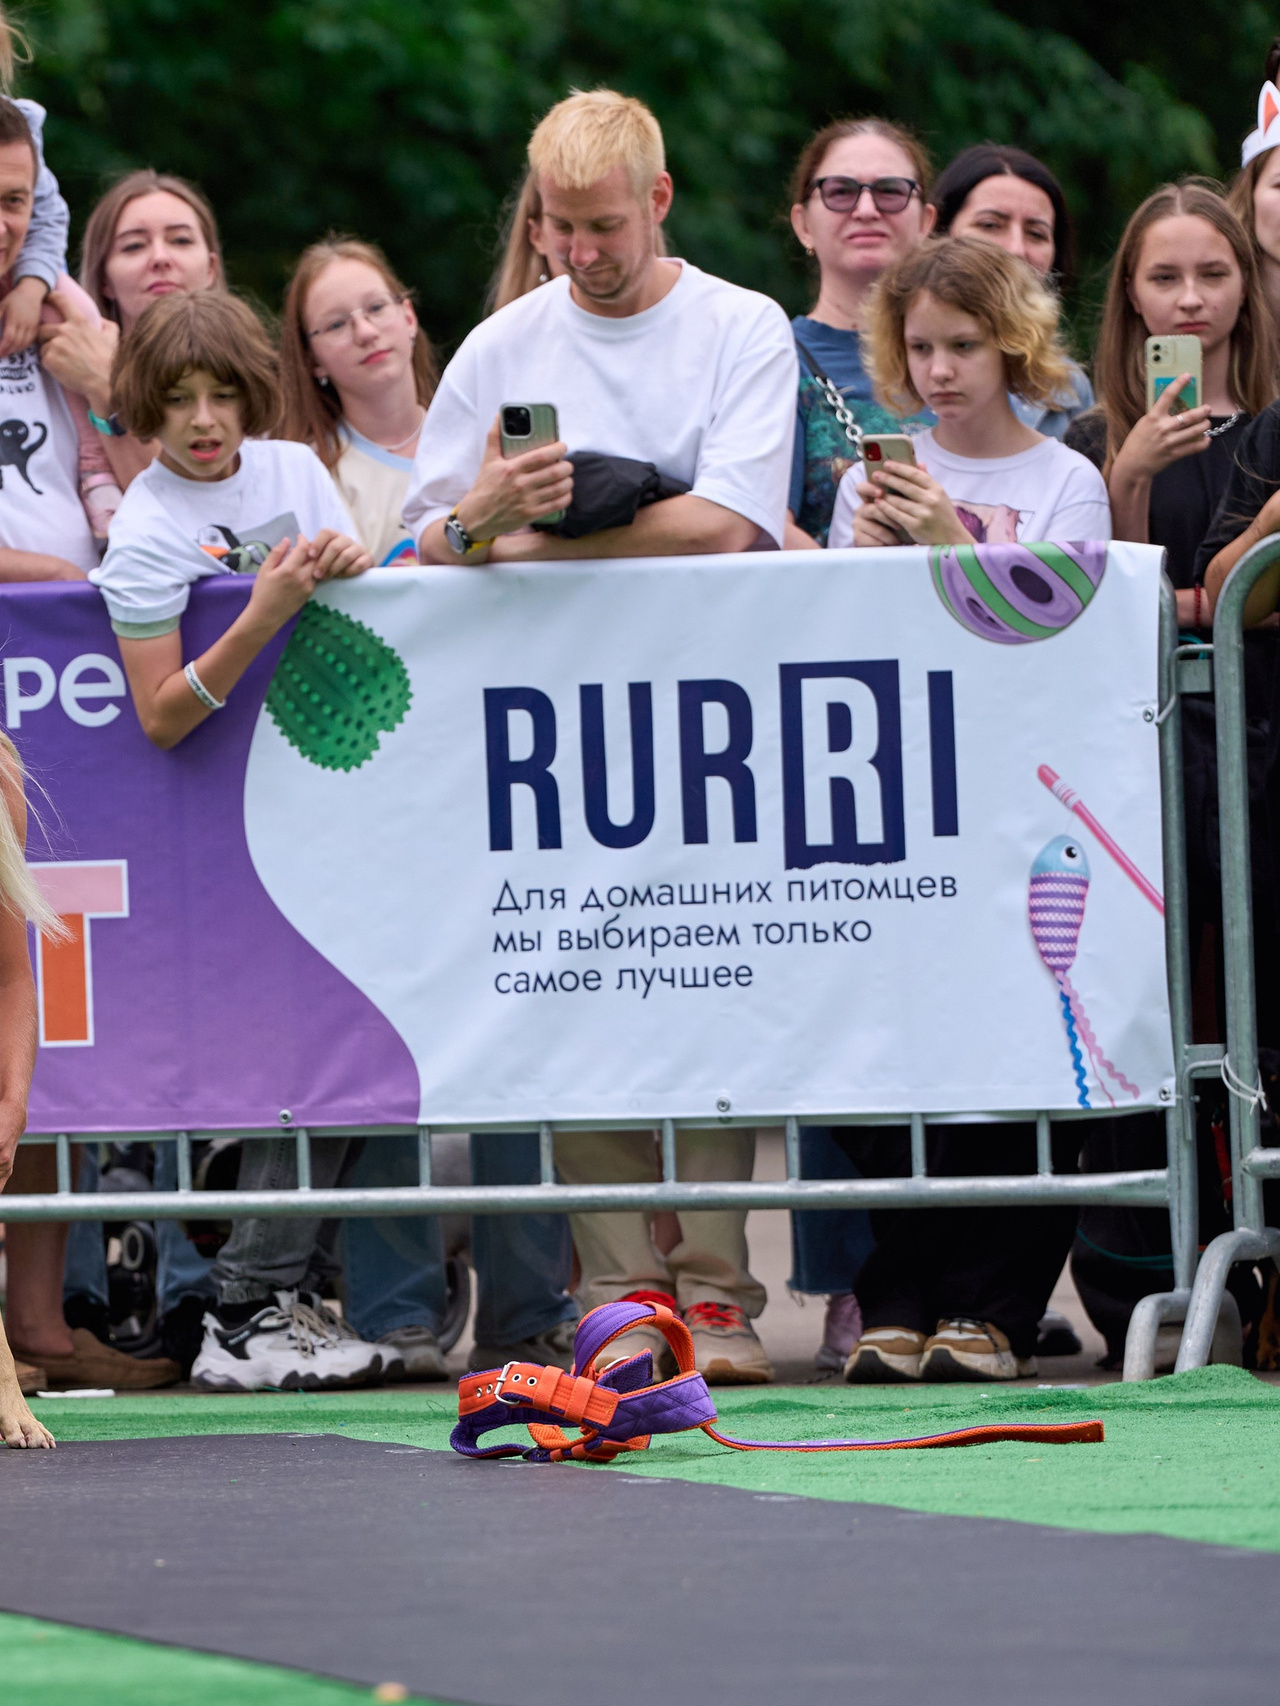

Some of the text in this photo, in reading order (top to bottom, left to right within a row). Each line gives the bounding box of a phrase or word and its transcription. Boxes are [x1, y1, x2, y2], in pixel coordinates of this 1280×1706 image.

[483, 666, 959, 855] RURRI
[492, 876, 958, 916] Для домашних питомцев
[493, 913, 872, 957] мы выбираем только
[494, 965, 753, 999] самое лучшее
